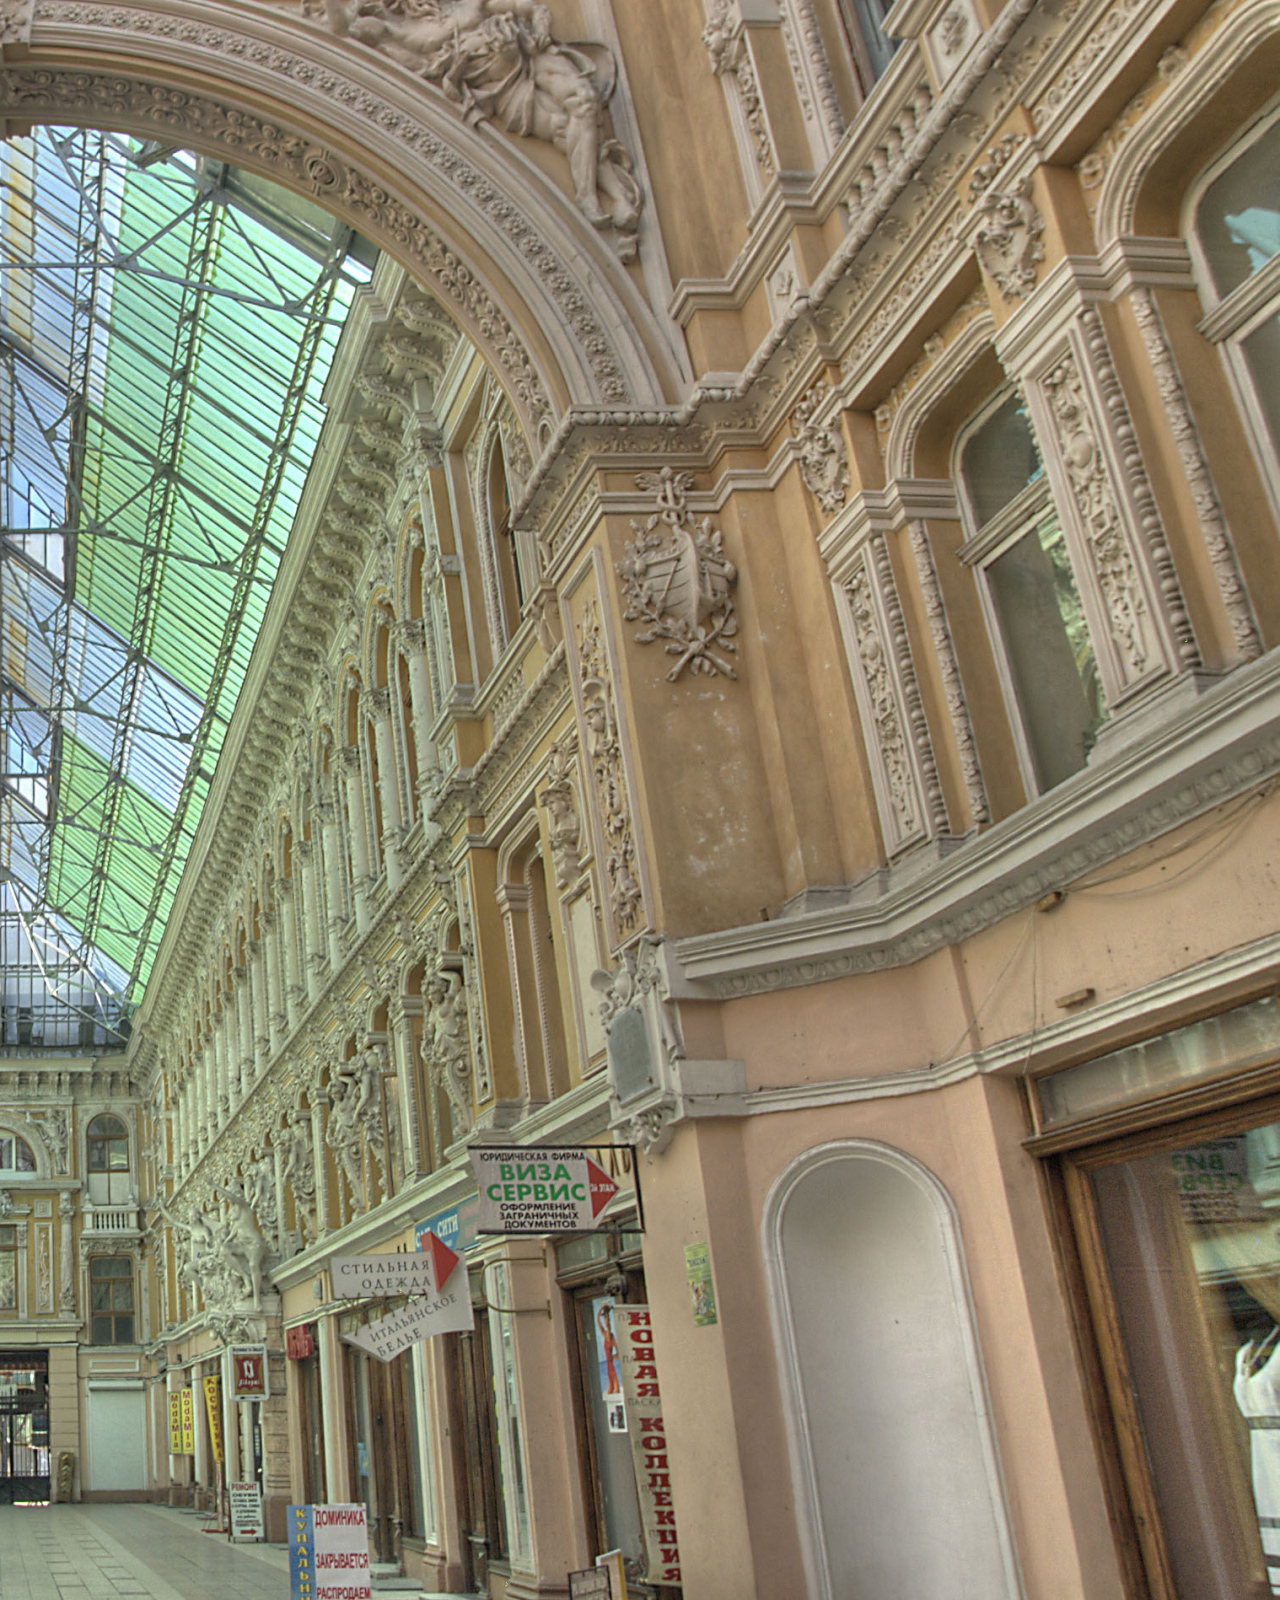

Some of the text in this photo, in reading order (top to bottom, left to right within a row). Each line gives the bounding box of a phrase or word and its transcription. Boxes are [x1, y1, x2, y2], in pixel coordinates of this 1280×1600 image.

[480, 1152, 585, 1161] ЮРИДИЧЕСКАЯ ФИРМА
[499, 1164, 572, 1181] ВИЗА
[486, 1184, 587, 1202] СЕРВИС
[500, 1203, 576, 1211] ОФОРМЛЕНИЕ
[499, 1211, 579, 1220] ЗАГРАНИЧНЫХ
[504, 1220, 577, 1229] ДОКУМЕНТОВ
[341, 1260, 430, 1275] СТИЛЬНАЯ
[362, 1276, 431, 1290] ОДЕЖДА
[370, 1293, 457, 1343] ИТАЛЬЯНСКОЕ
[377, 1327, 423, 1357] БЕЛЬЕ
[627, 1311, 660, 1397] НОВАЯ
[638, 1417, 682, 1582] КОЛЛЕКЦИЯ
[315, 1553, 369, 1568] ЗАКРЫВАЕТСЯ
[316, 1587, 371, 1600] РАСПРОДАЕМ
